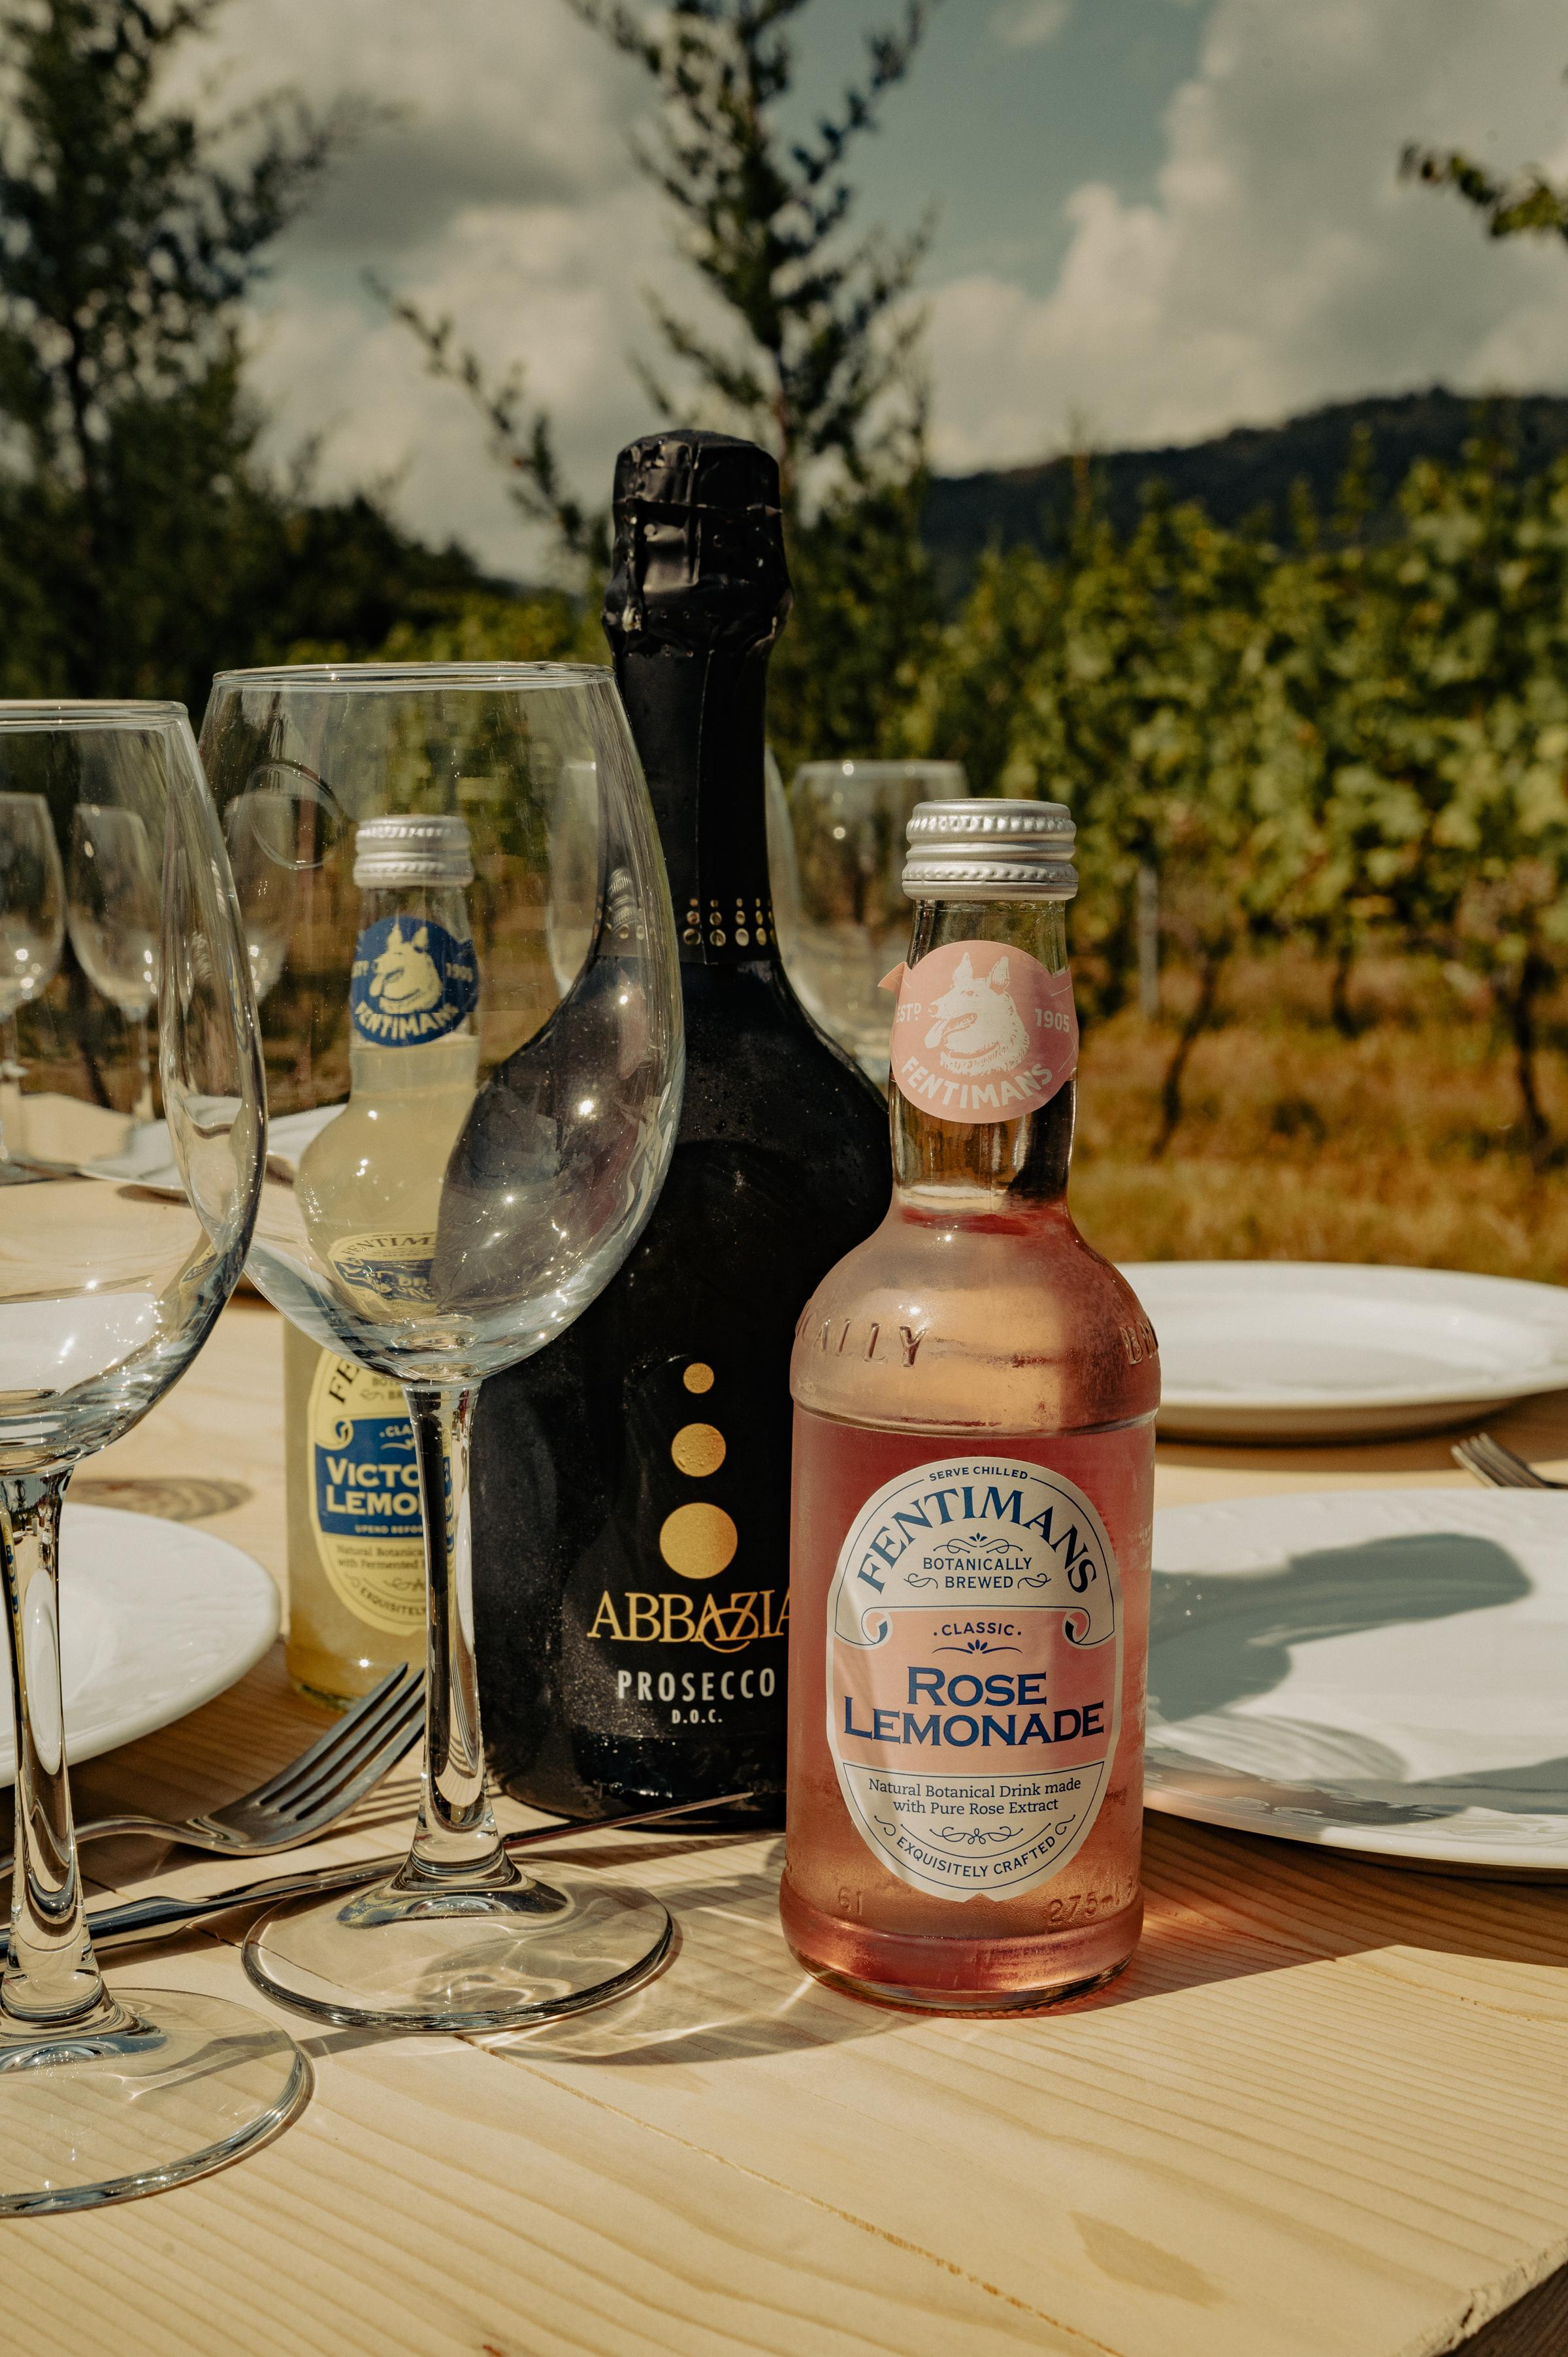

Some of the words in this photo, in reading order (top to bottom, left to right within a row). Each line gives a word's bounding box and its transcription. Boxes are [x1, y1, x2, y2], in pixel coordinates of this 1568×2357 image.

[1035, 1008, 1070, 1033] 1905
[900, 1055, 1053, 1110] FENTIMANS
[341, 1236, 436, 1256] FENTIM
[326, 1456, 419, 1488] VICTO
[929, 1466, 970, 1482] SERVE
[973, 1466, 1028, 1480] CHILLED
[326, 1485, 423, 1516] LEMO
[857, 1486, 1098, 1594] FENTIMANS
[923, 1557, 1032, 1570] BOTANICALLY
[945, 1577, 1013, 1589] BREWED
[941, 1622, 1015, 1636] CLASSIC
[618, 1668, 776, 1702] PROSECCO
[907, 1666, 1047, 1707] ROSE
[672, 1709, 723, 1724] D.O.C.
[843, 1696, 1104, 1747] LEMONADE
[868, 1778, 921, 1797] Natural
[926, 1785, 995, 1798] Botanical
[999, 1783, 1041, 1797] Drink
[1045, 1777, 1081, 1795] made
[892, 1799, 926, 1814] with
[930, 1802, 964, 1815] Pure
[969, 1802, 1004, 1815] Rose
[1009, 1798, 1058, 1813] Extract
[896, 1836, 988, 1877] EXQUISITELY
[993, 1836, 1056, 1875] CRAFTED
